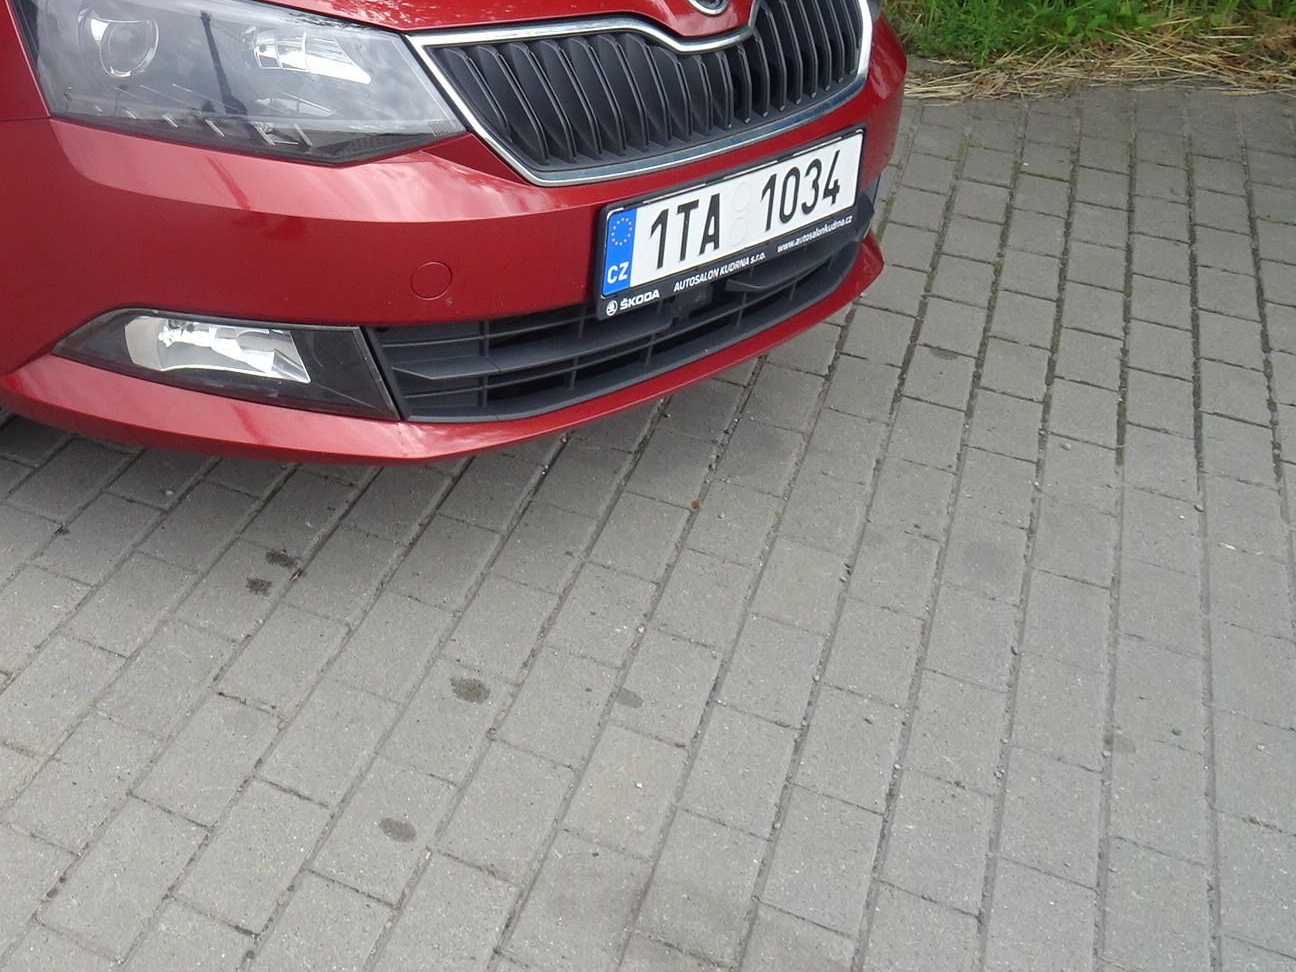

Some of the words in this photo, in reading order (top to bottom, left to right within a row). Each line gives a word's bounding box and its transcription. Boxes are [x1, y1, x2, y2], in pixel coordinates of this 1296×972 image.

[649, 193, 721, 270] 1TA
[760, 149, 841, 232] 1034
[606, 261, 630, 285] CZ
[673, 267, 720, 293] AUTOSALON
[719, 256, 750, 276] KUDRNA
[749, 252, 766, 265] s.r.o.
[619, 288, 660, 310] ŠKODA
